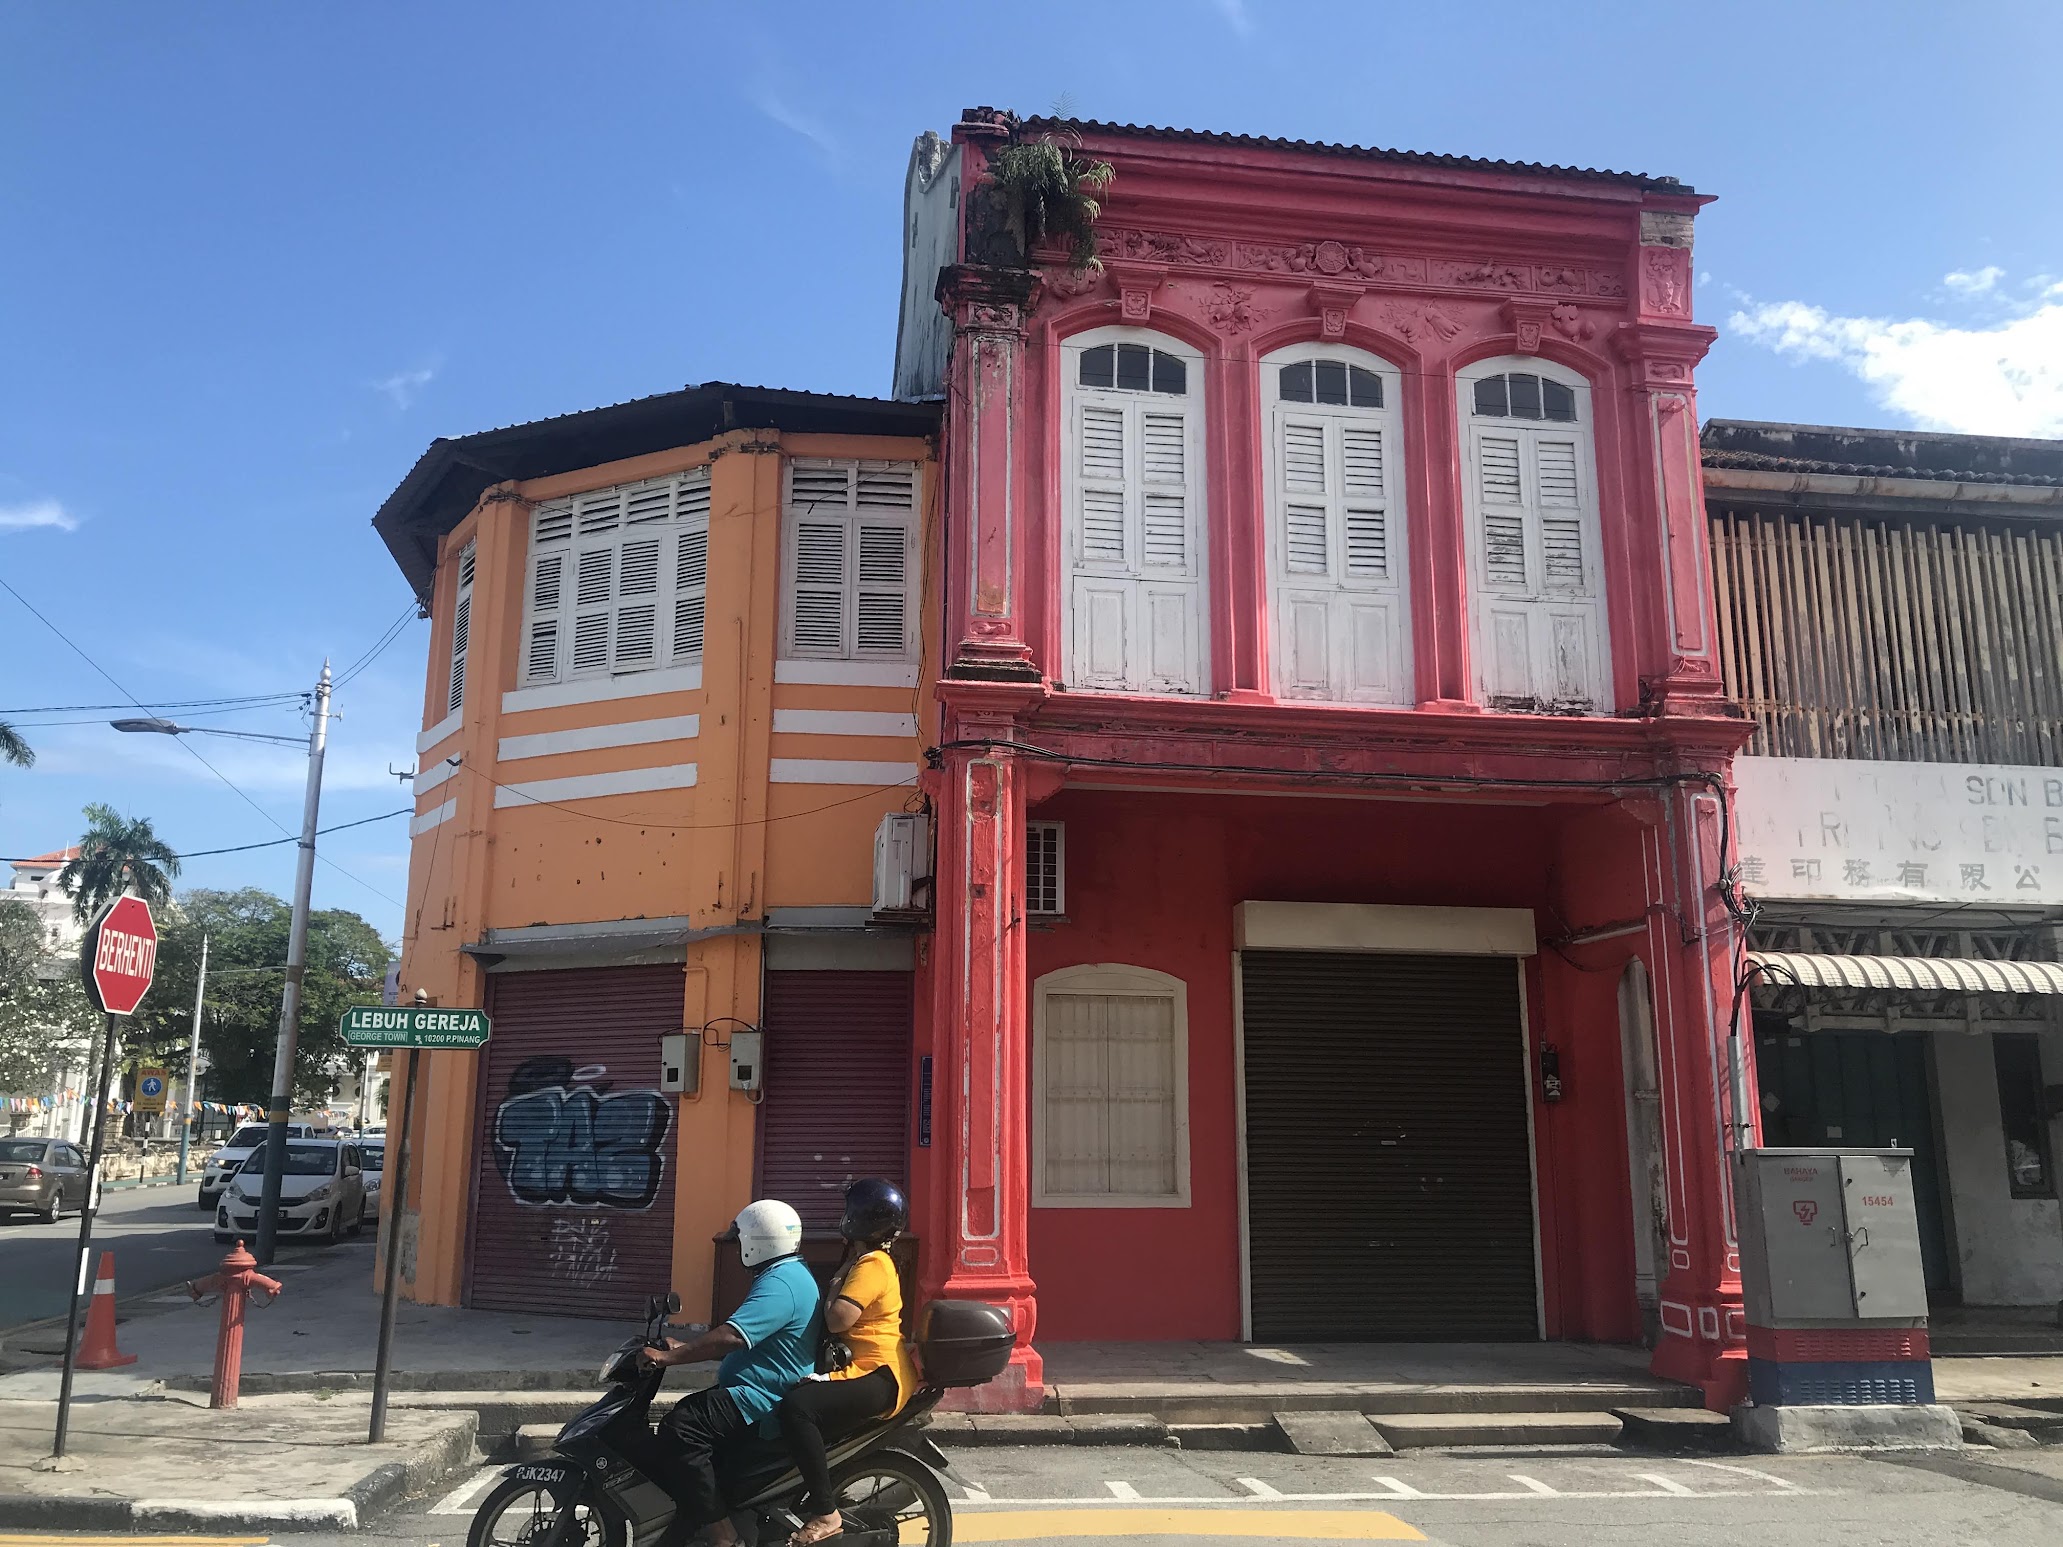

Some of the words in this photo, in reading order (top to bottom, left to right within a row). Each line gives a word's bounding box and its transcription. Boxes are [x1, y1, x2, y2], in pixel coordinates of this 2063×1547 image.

[98, 928, 154, 980] BERHENTI
[351, 1011, 408, 1029] LEBUH
[414, 1013, 481, 1031] GEREJA
[350, 1031, 382, 1041] GEORGE
[384, 1032, 406, 1042] TOWN
[424, 1034, 445, 1043] 10200
[446, 1034, 481, 1044] P.PINANG
[1784, 1167, 1818, 1175] BAHAYA
[1862, 1196, 1893, 1206] 15454
[516, 1466, 566, 1482] PJK2347
